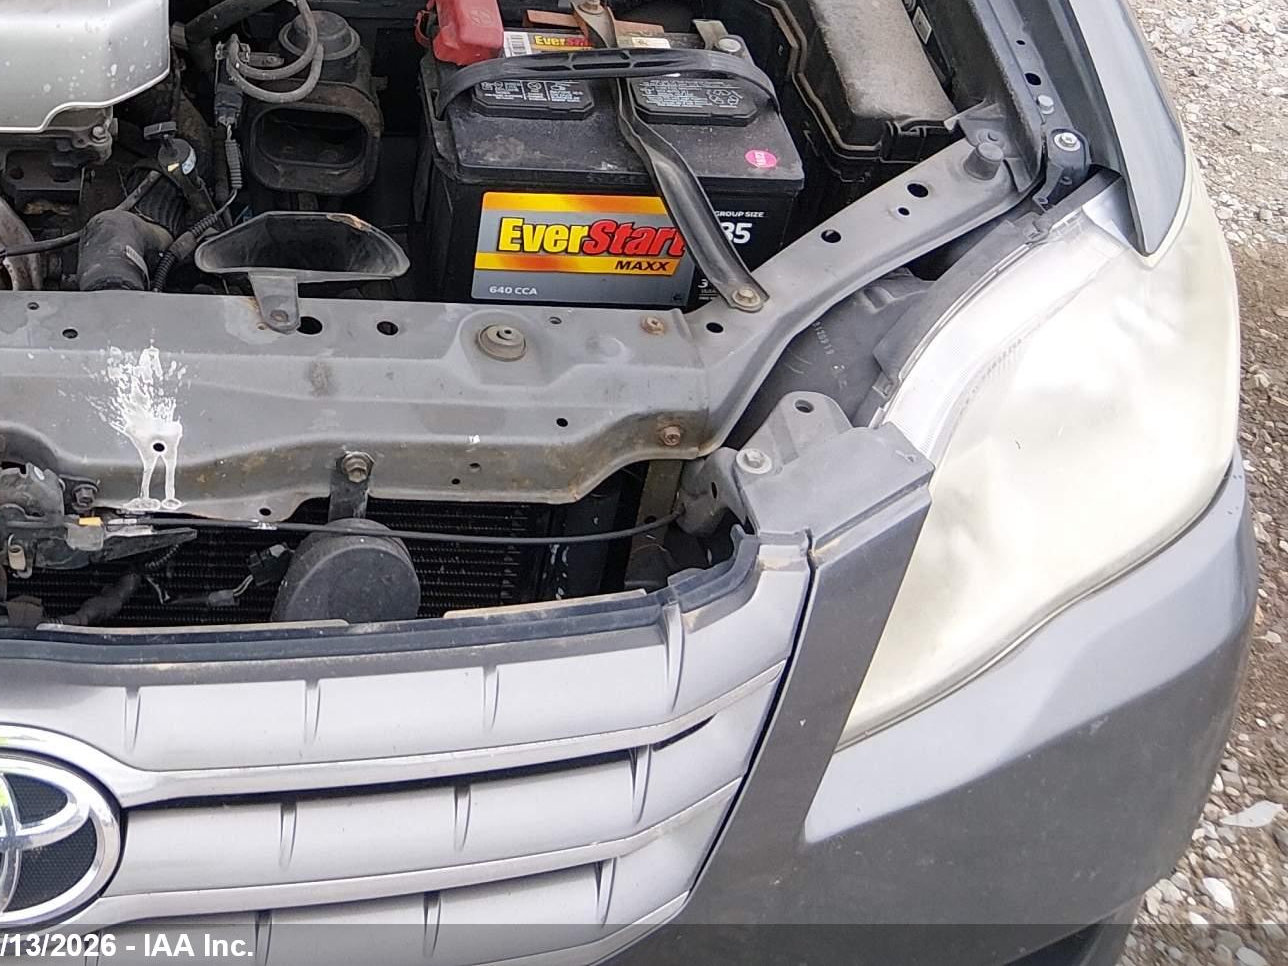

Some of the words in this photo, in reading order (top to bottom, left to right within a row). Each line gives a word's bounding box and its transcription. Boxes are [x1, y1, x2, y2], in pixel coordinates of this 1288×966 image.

[713, 210, 745, 218] GROUP
[497, 217, 686, 256] EverStart
[614, 260, 670, 271] MAXX
[489, 285, 512, 295] 640
[514, 286, 538, 295] CCA
